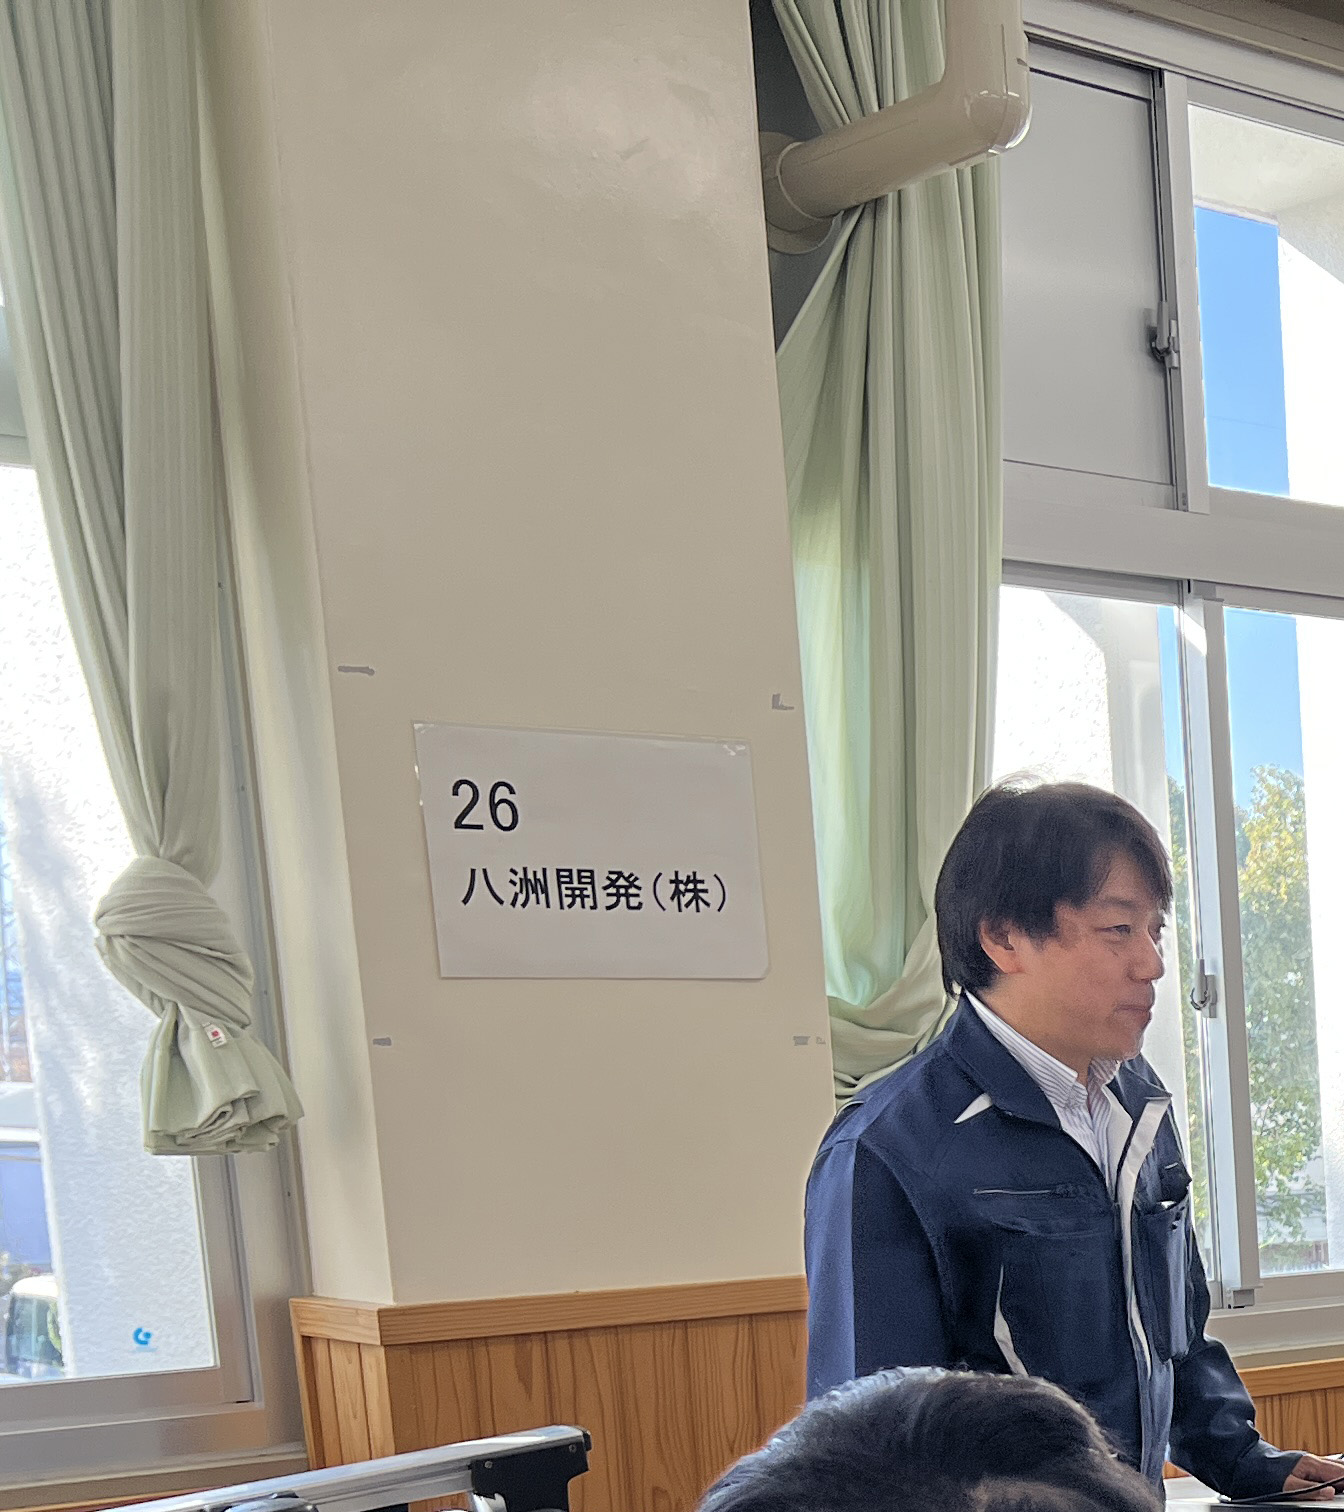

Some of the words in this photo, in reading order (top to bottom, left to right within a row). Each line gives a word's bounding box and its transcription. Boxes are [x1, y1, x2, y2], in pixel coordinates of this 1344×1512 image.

[450, 779, 520, 832] 26
[461, 866, 727, 914] 八洲開発(株)
